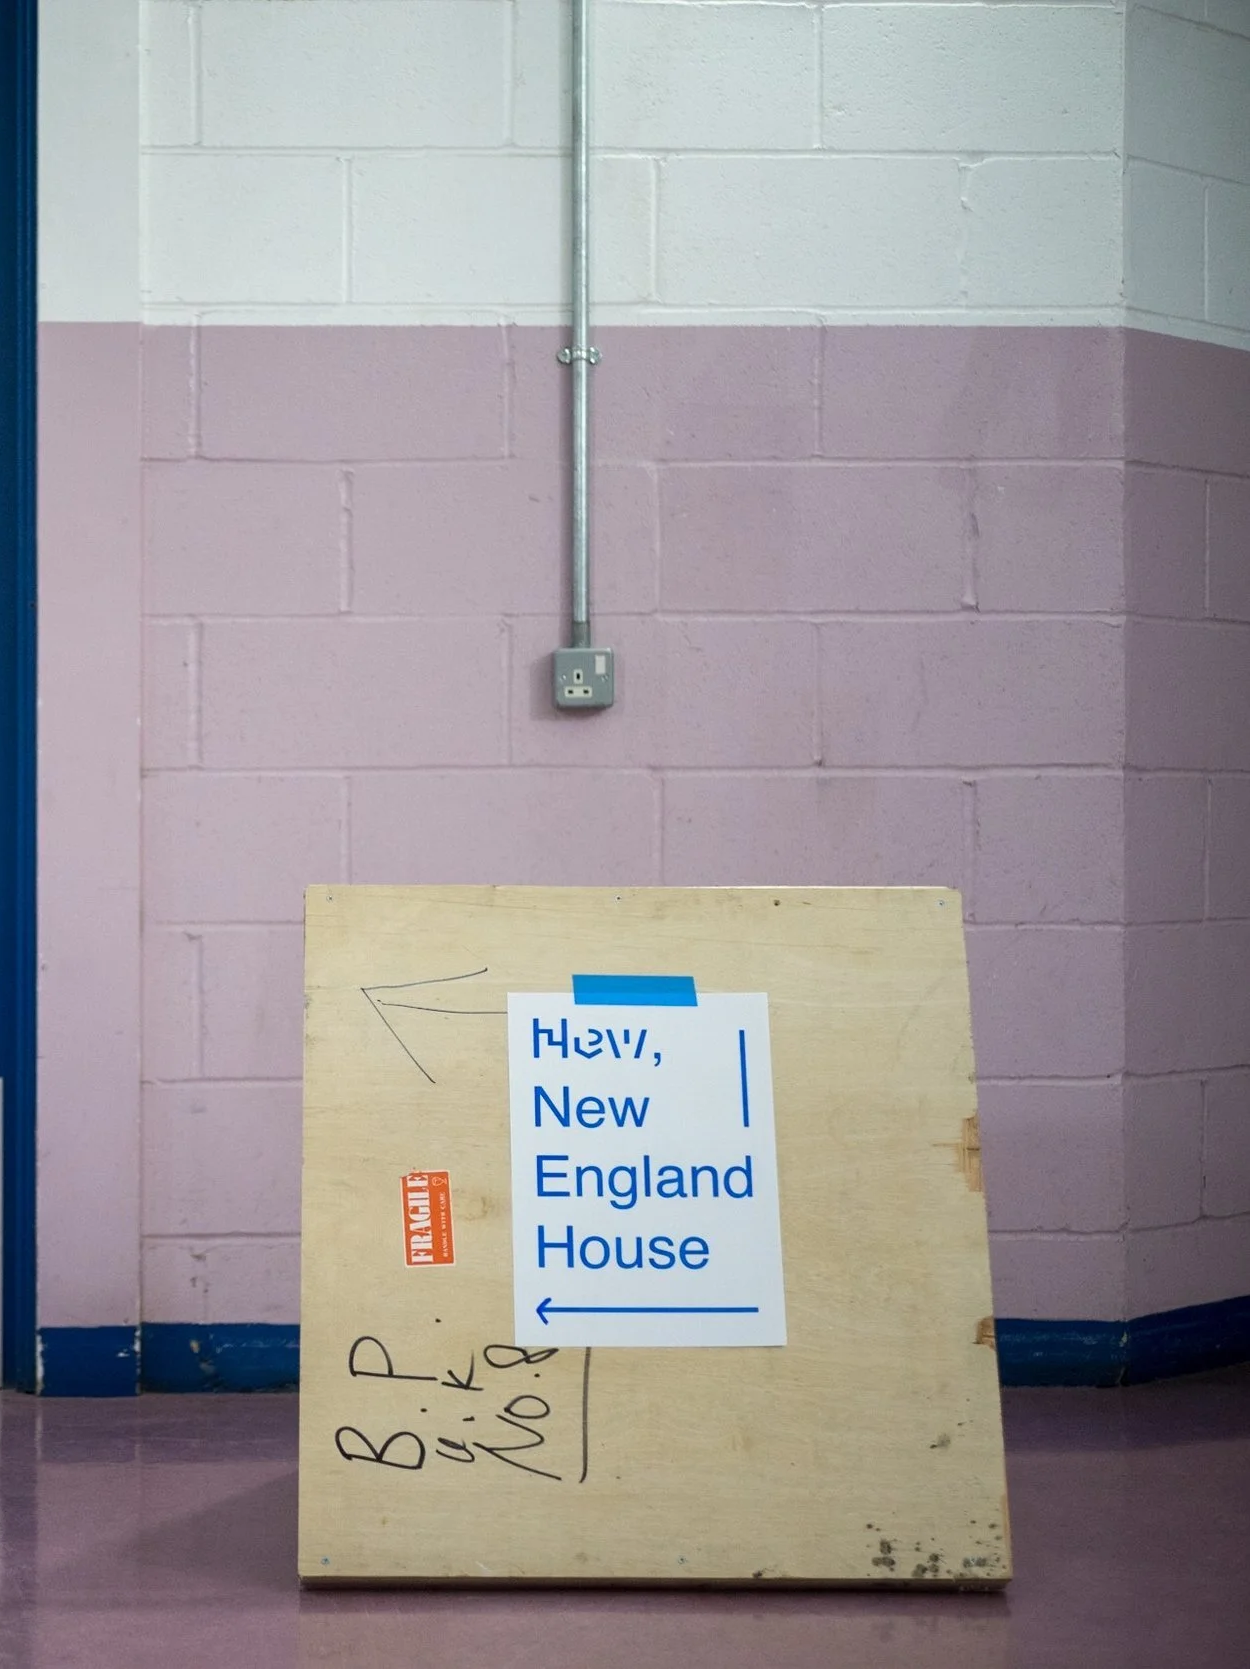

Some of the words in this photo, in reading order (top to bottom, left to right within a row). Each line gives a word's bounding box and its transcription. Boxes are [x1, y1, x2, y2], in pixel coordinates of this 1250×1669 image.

[534, 1085, 650, 1129] New
[536, 1154, 754, 1211] England
[406, 1174, 434, 1265] FRAGILE
[537, 1224, 710, 1271] House
